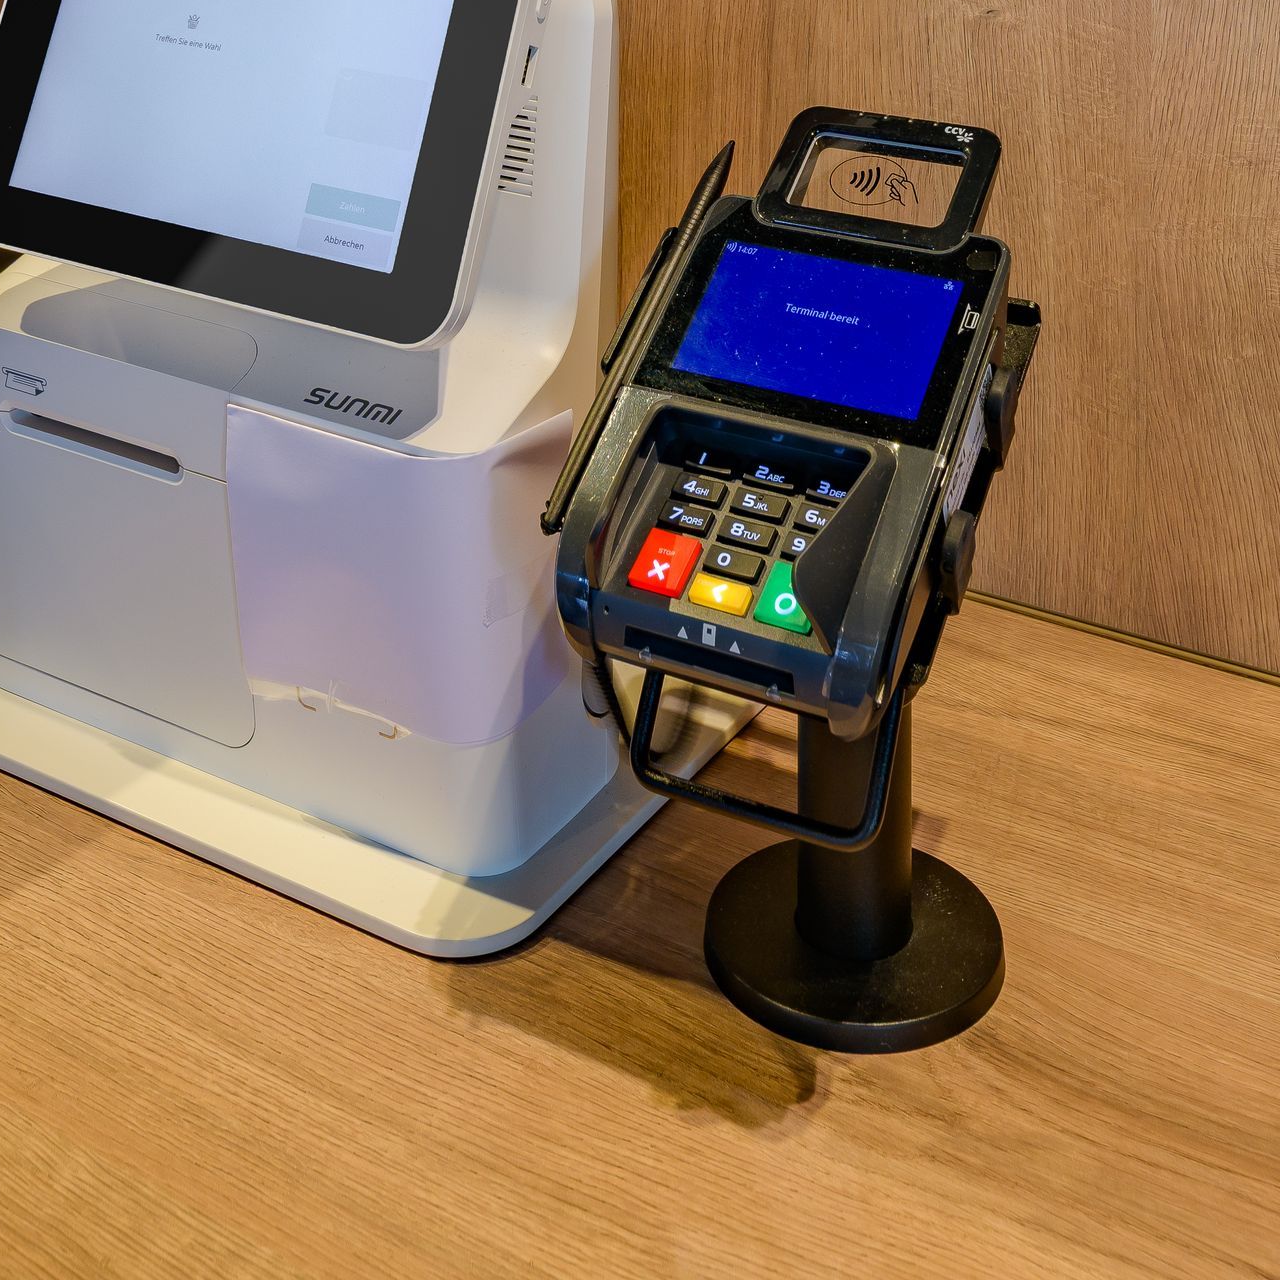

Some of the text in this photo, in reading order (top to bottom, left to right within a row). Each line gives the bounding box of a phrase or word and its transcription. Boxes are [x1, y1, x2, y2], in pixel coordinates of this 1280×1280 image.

[155, 33, 222, 51] Treffen Sie eine Wahl
[944, 125, 966, 137] CCV
[339, 200, 366, 215] Zahlen
[324, 235, 365, 251] Abbrechen
[737, 245, 758, 256] 14:07
[785, 303, 860, 326] Terminal bereit
[303, 386, 404, 426] SUNMI
